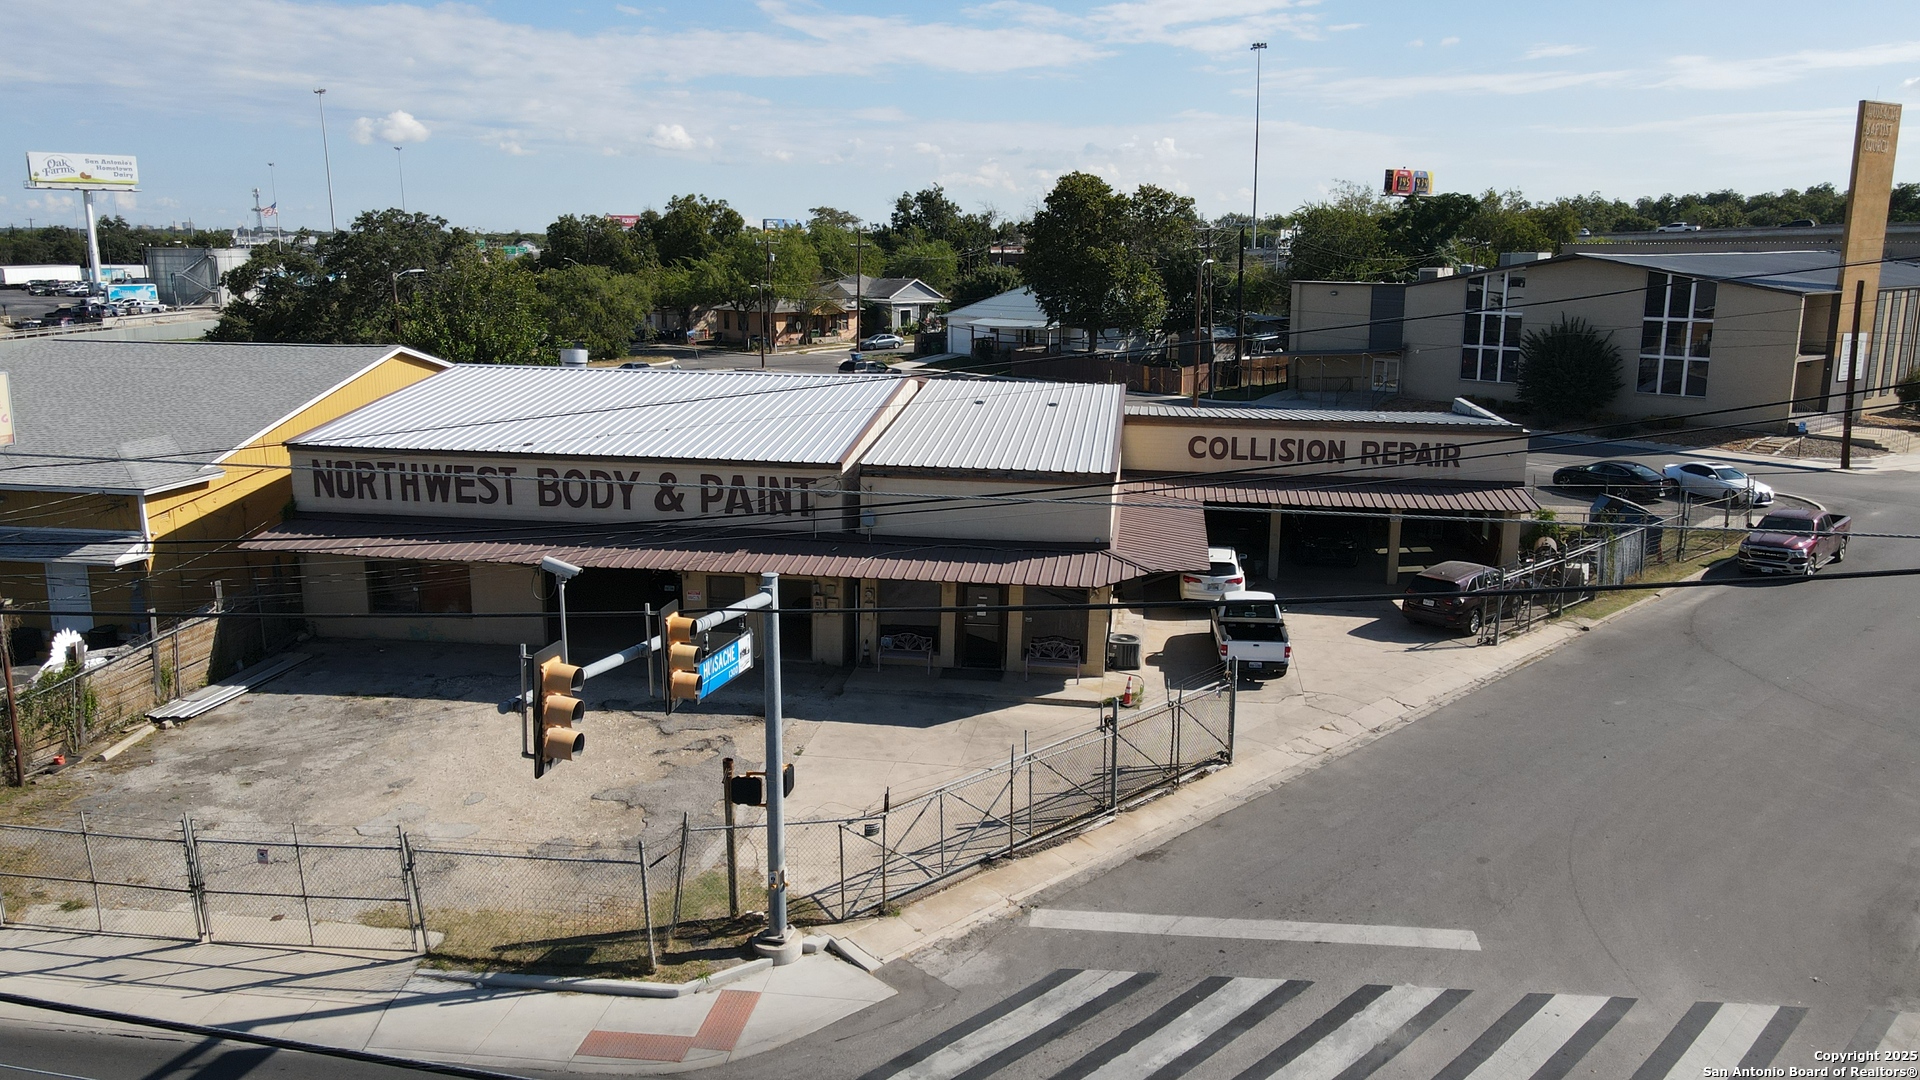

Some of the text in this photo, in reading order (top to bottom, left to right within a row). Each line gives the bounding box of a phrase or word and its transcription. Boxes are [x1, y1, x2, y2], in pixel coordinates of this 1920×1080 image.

[47, 158, 71, 169] Oak
[42, 166, 76, 176] Farms
[113, 171, 134, 179] Dairy
[1187, 435, 1462, 468] COLLISION REPAIR
[311, 459, 817, 517] NORTHWEST BODY & PAINT
